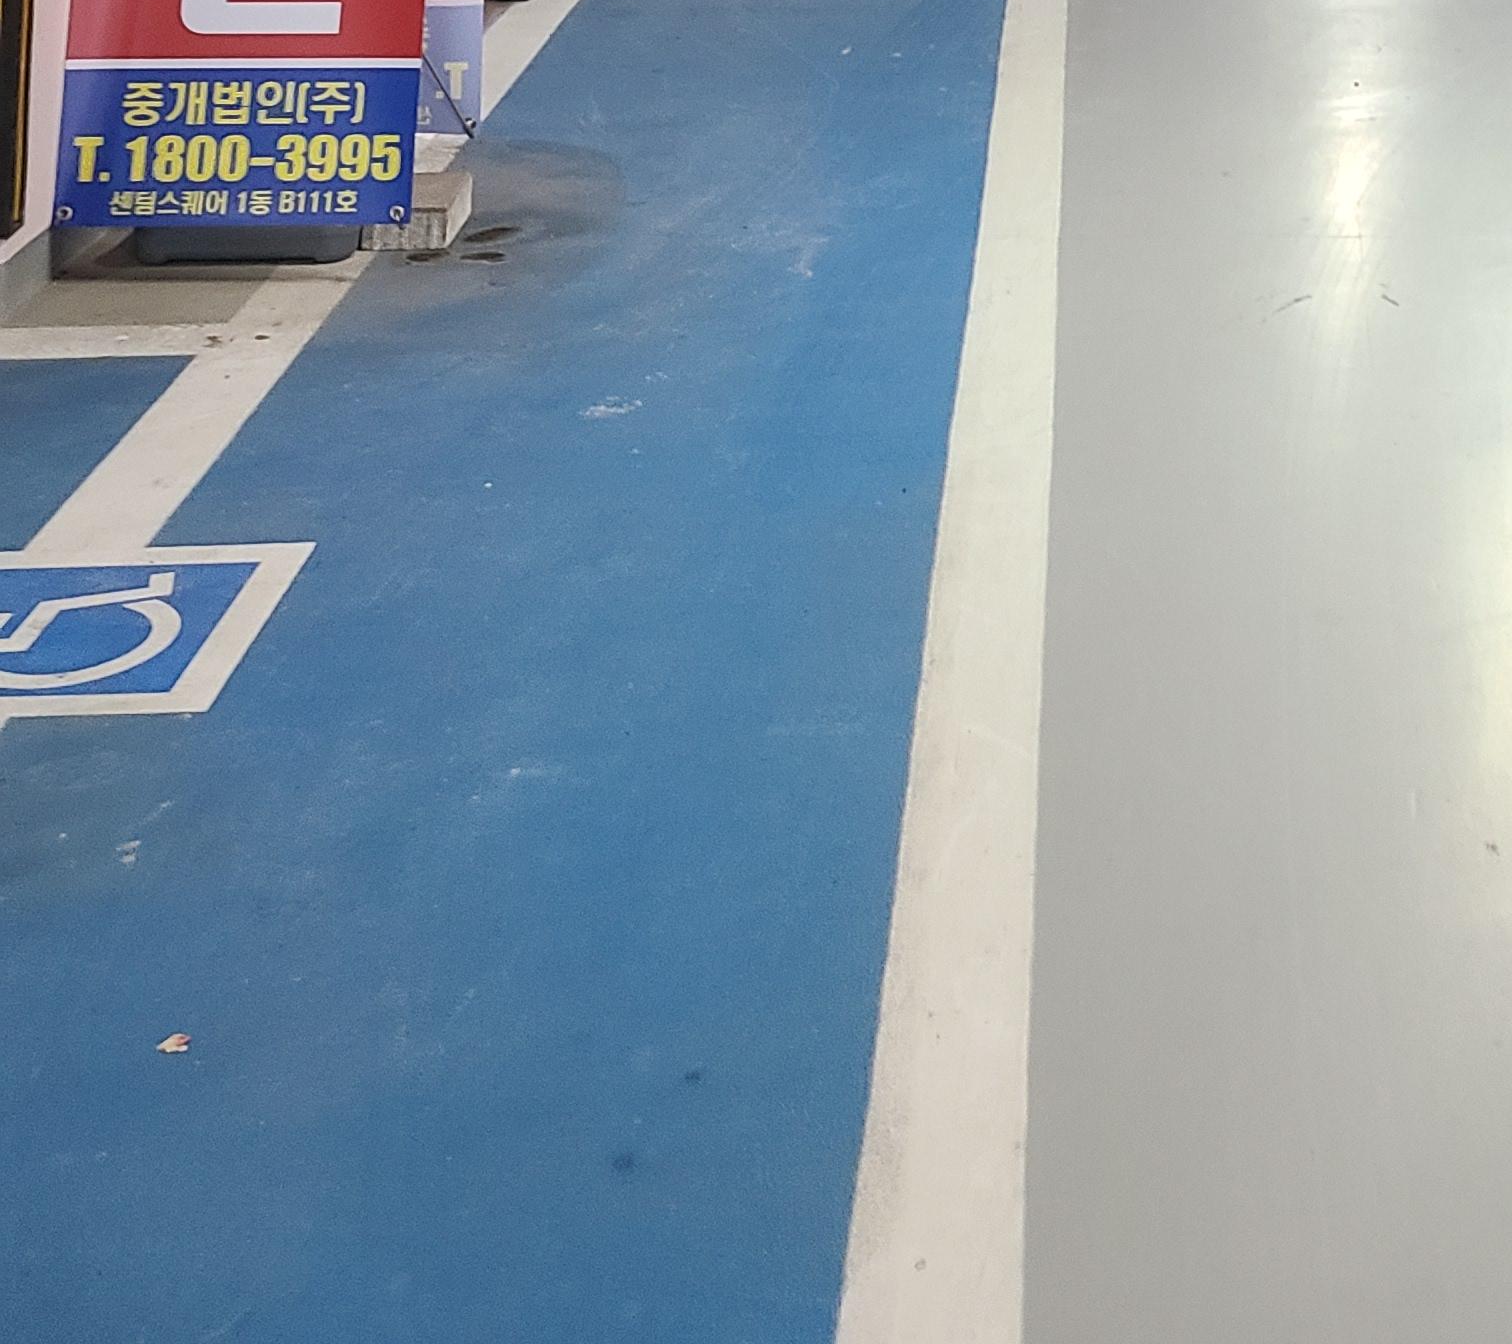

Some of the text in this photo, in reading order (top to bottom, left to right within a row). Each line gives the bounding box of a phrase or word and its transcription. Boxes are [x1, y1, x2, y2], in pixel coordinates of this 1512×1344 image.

[121, 80, 367, 127] 중개법인(주)
[73, 133, 401, 183] T. 1800-3995
[108, 188, 359, 217] 센텀스퀘어 1동 B111호
